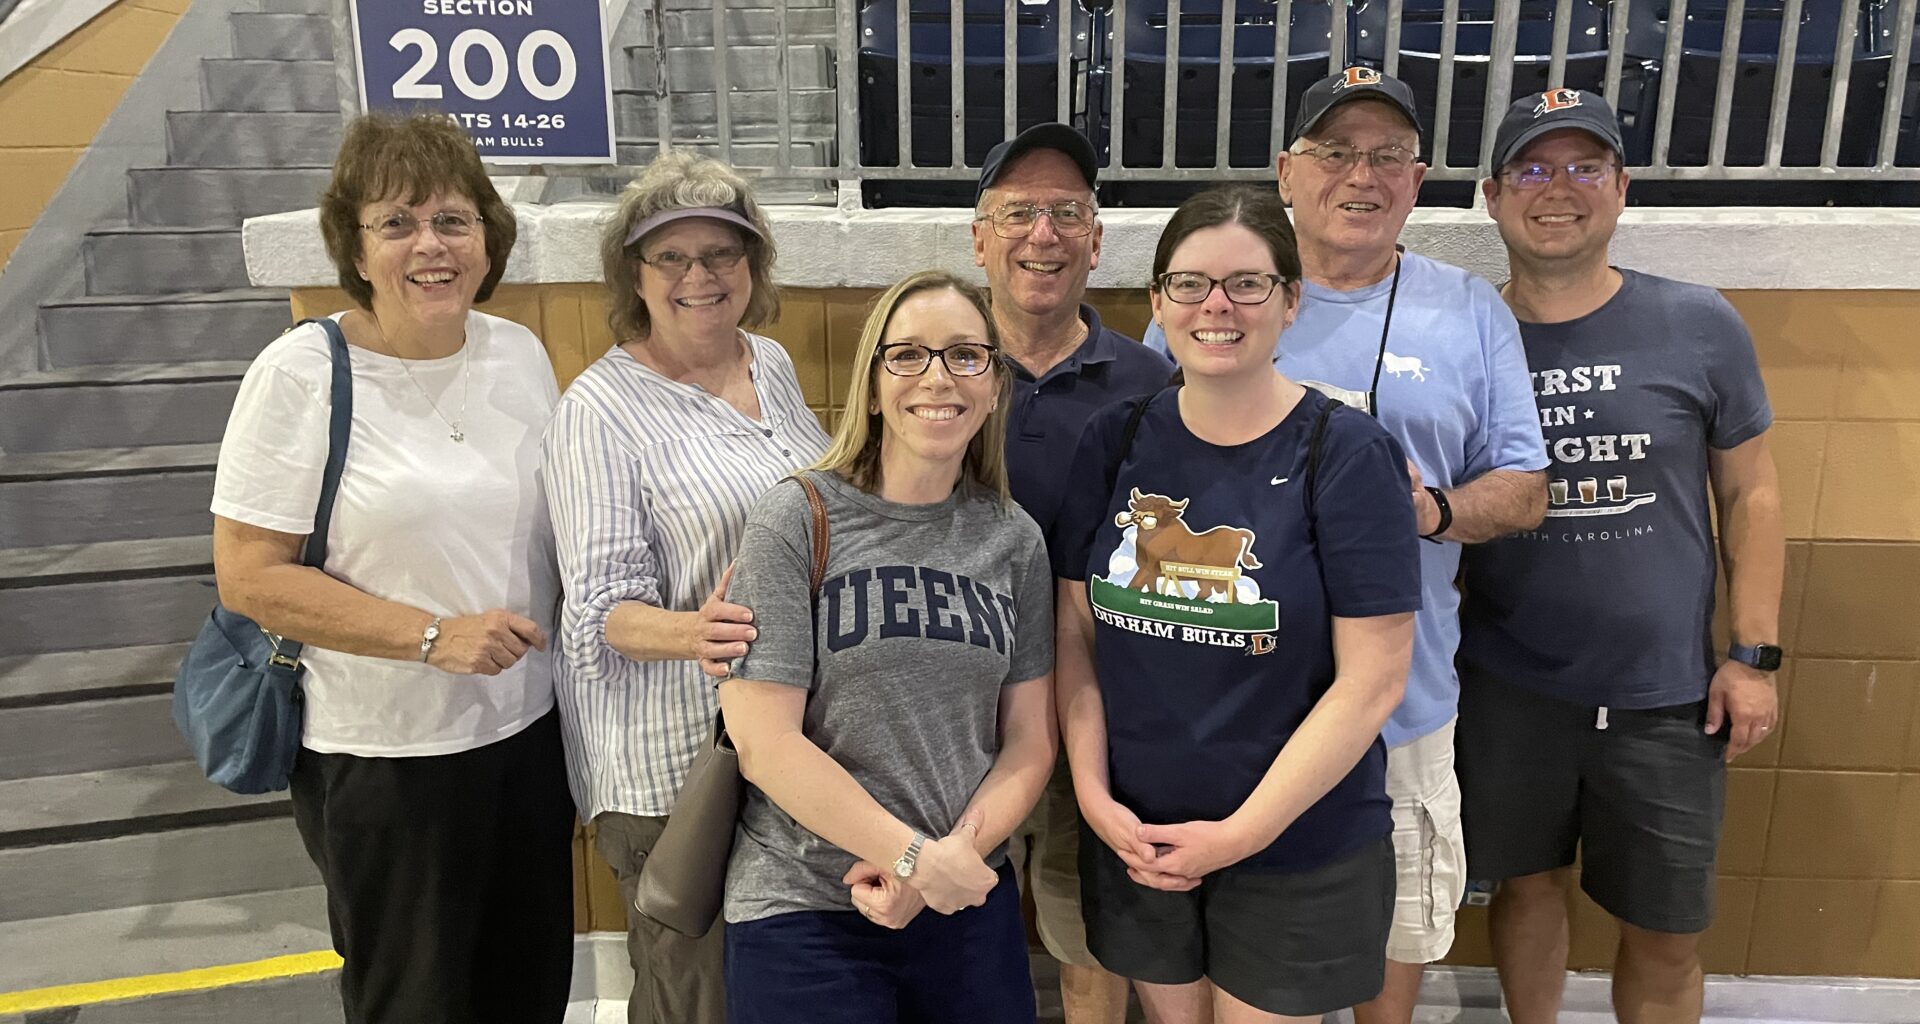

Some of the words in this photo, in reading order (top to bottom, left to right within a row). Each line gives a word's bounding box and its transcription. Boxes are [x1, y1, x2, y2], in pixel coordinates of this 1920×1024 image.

[423, 0, 533, 16] SECTION
[388, 28, 577, 101] 200
[501, 113, 566, 129] 14-26
[501, 137, 544, 147] BULLS
[1540, 405, 1576, 427] IN
[1562, 525, 1653, 543] CAROLINA
[1178, 566, 1195, 574] BULL
[1139, 598, 1153, 606] HIT
[1152, 600, 1175, 610] GRASS
[1174, 604, 1190, 612] WIN
[1190, 606, 1214, 615] SALAD
[1092, 605, 1175, 640] DURHAM
[1182, 626, 1246, 648] BULLS
